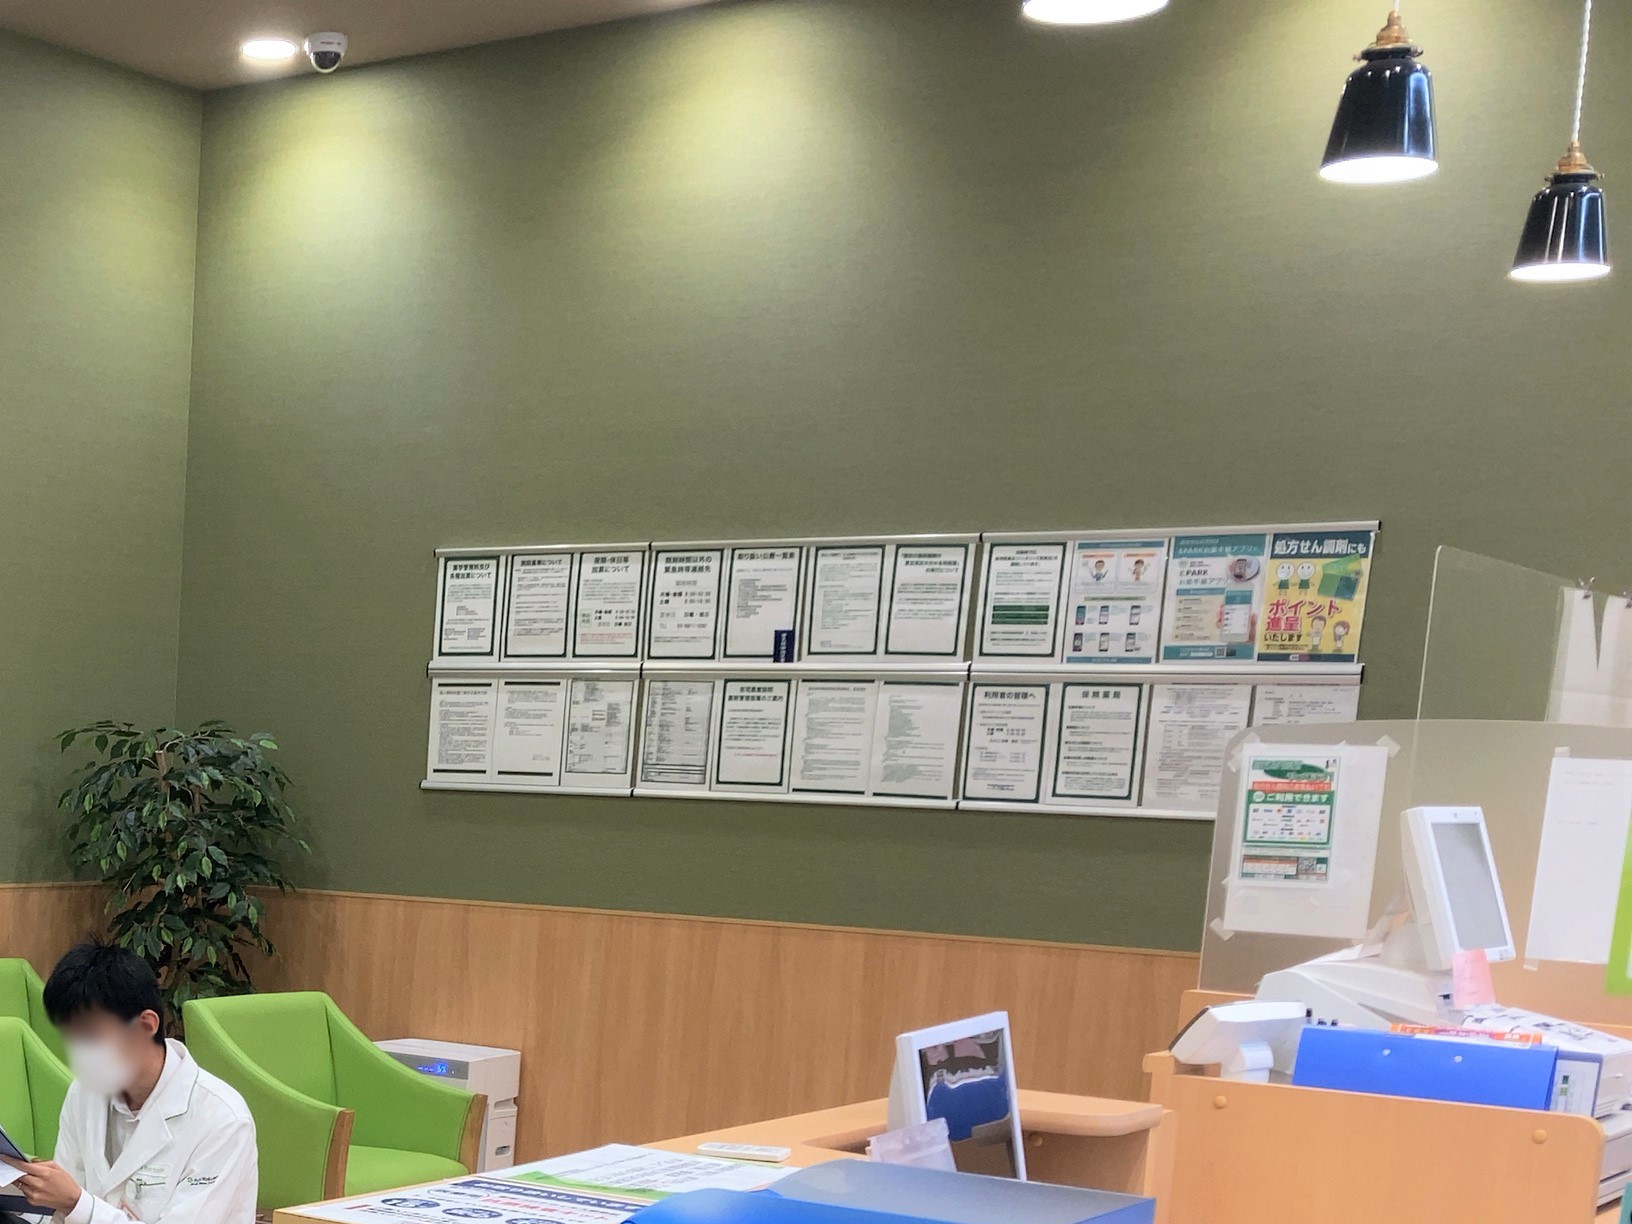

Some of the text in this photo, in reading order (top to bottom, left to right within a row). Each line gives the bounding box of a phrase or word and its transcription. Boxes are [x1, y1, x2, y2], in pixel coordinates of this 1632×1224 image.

[1275, 538, 1367, 555] 処方せん調剤にも
[1270, 599, 1342, 619] ポイント
[1266, 616, 1302, 632] 進呈
[1264, 633, 1303, 643] いたします
